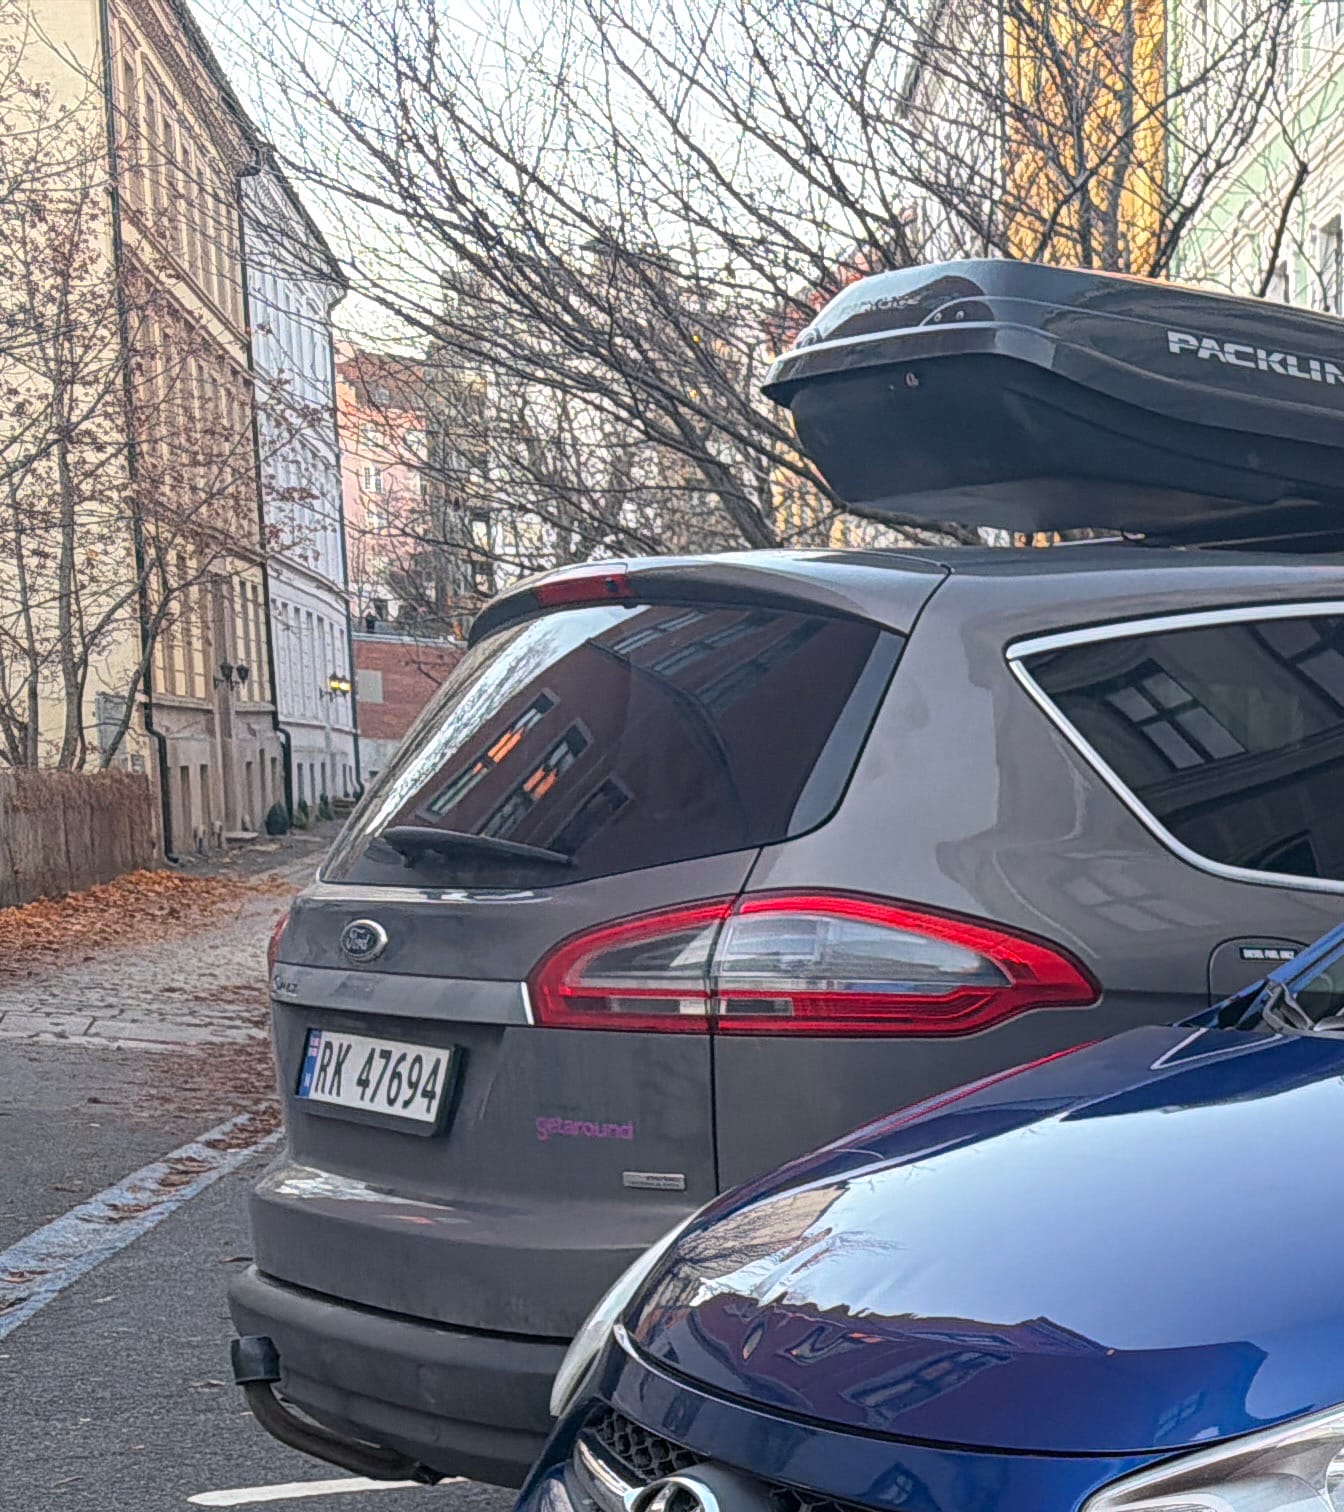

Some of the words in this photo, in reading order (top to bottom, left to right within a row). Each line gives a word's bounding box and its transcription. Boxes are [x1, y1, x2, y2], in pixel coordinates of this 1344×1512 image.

[314, 1040, 352, 1097] RK
[356, 1047, 442, 1114] 47694
[536, 1117, 634, 1141] getaround
